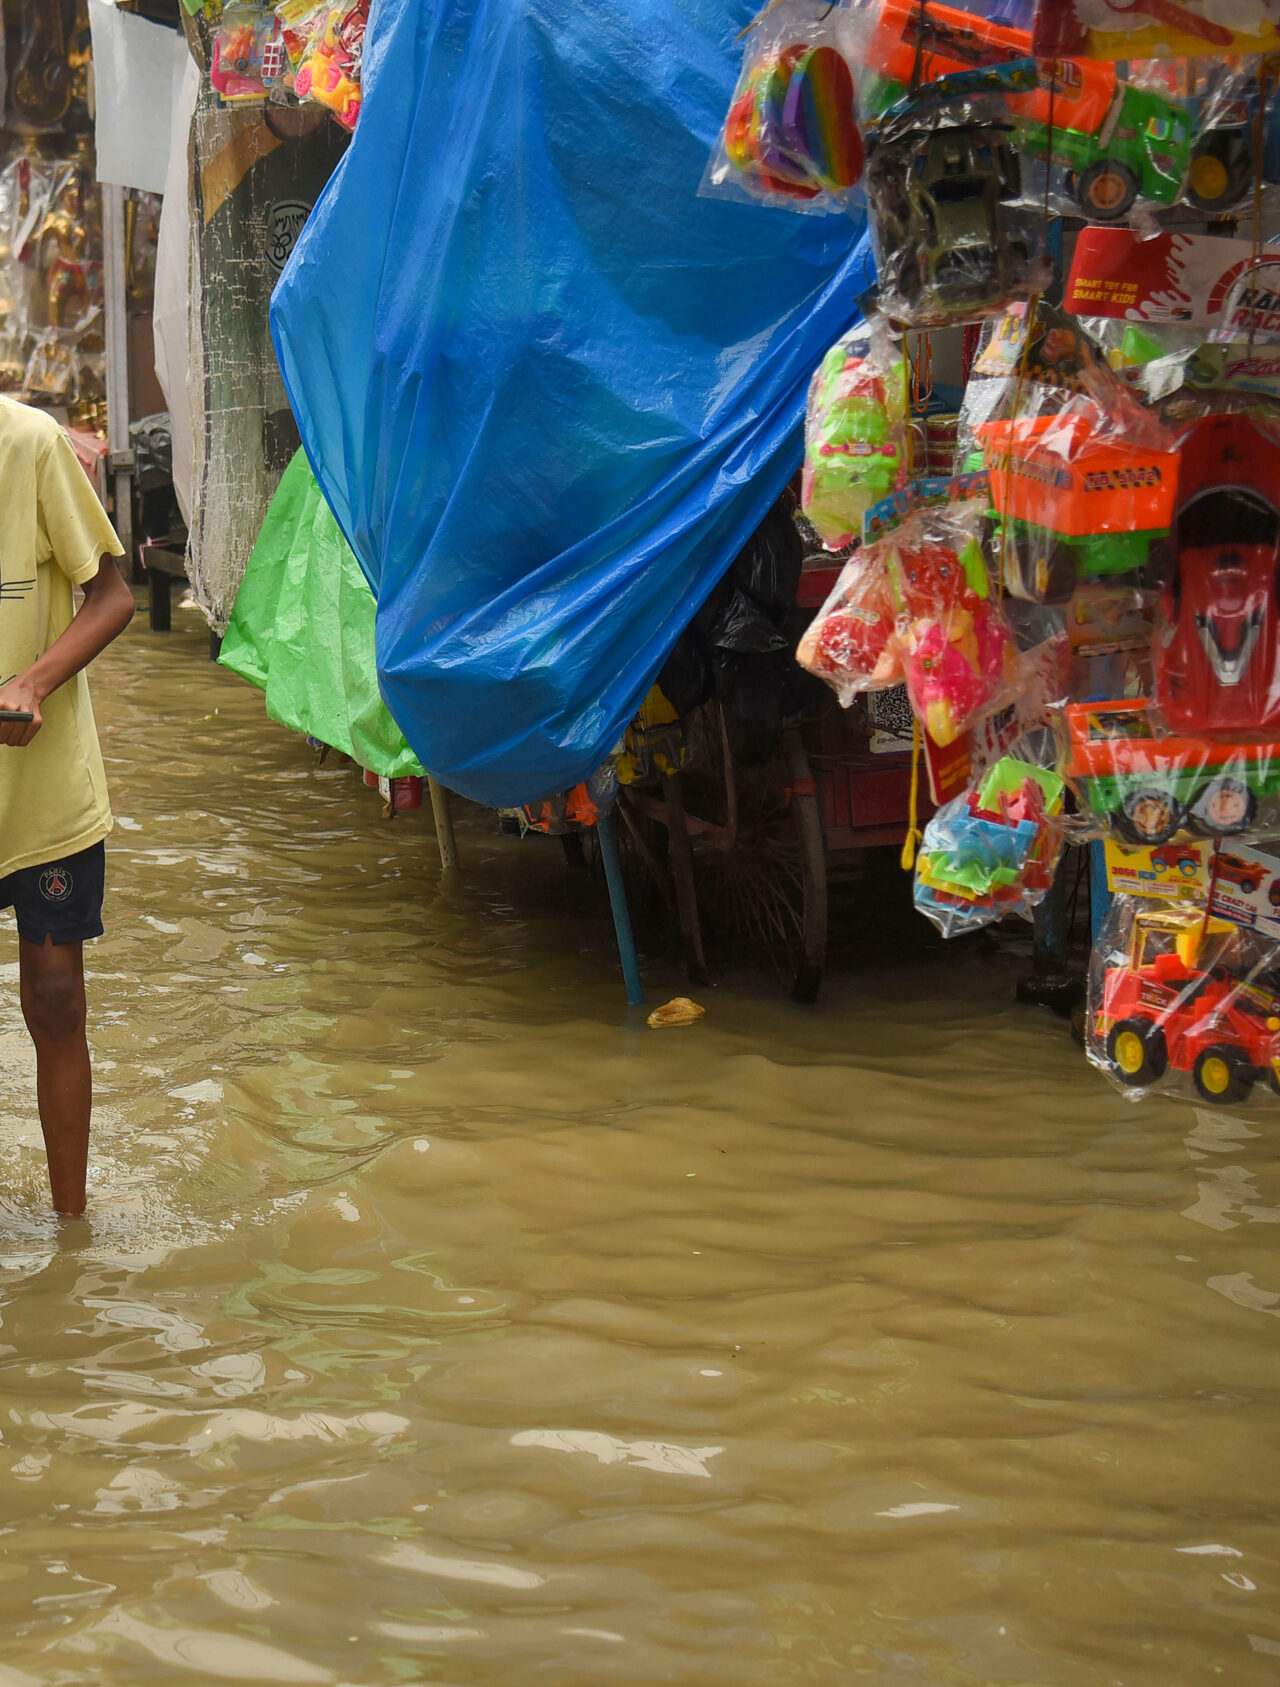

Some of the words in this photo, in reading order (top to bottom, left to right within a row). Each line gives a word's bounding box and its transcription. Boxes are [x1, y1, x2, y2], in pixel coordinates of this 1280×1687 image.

[1074, 278, 1102, 289] SMART
[1072, 289, 1110, 302] SMART
[1111, 292, 1137, 305] KIDS
